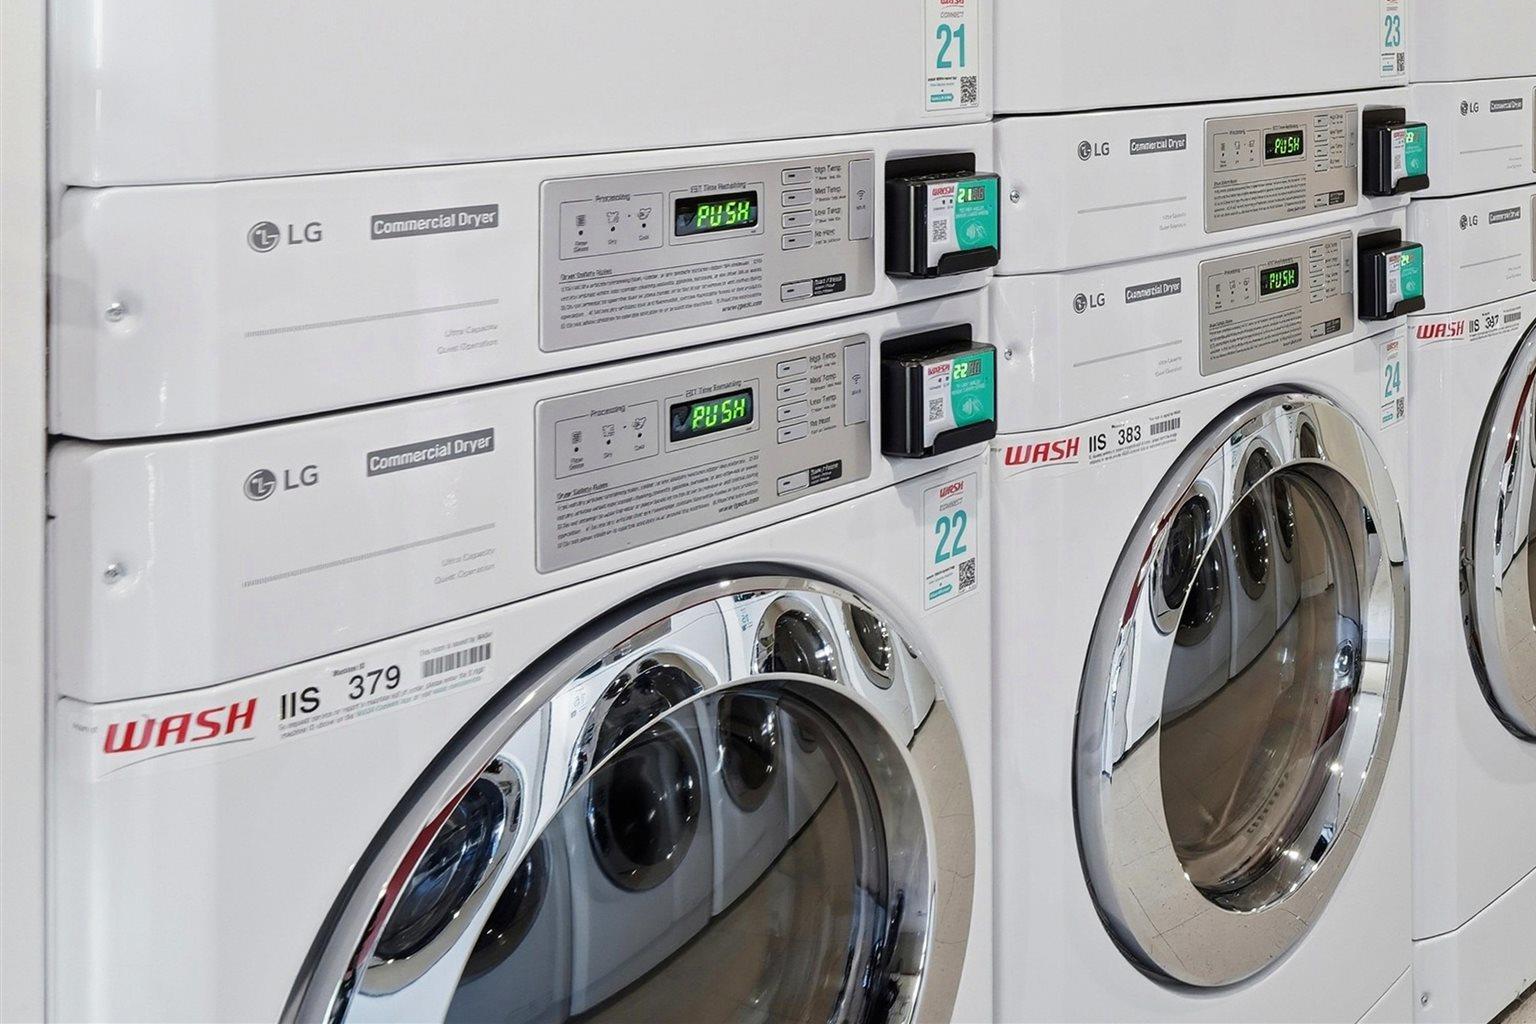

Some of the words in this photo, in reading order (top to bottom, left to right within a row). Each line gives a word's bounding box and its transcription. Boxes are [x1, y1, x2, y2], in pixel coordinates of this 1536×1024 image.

[1384, 15, 1401, 47] 23
[936, 23, 965, 69] 21
[1469, 102, 1479, 113] LG
[1094, 142, 1110, 157] LG
[1274, 136, 1300, 154] PUSH
[957, 188, 972, 203] 21
[373, 214, 456, 236] Commercial
[459, 212, 496, 227] Dryer
[697, 201, 750, 228] PUSH
[1469, 215, 1478, 226] LG
[288, 221, 323, 245] LG
[1269, 269, 1295, 290] PUSH
[1089, 293, 1106, 308] LG
[1416, 320, 1465, 339] WASH
[1384, 361, 1401, 398] 24
[692, 398, 745, 431] PUSH
[369, 444, 451, 472] Commercial
[454, 436, 492, 455] Dryer
[1004, 436, 1080, 466] WASH
[1089, 434, 1107, 453] IIS
[1118, 425, 1142, 445] 383
[284, 465, 319, 491] LG
[935, 509, 967, 564] 22
[102, 697, 258, 754] WASH
[281, 686, 320, 721] IIS
[349, 665, 401, 700] 379
